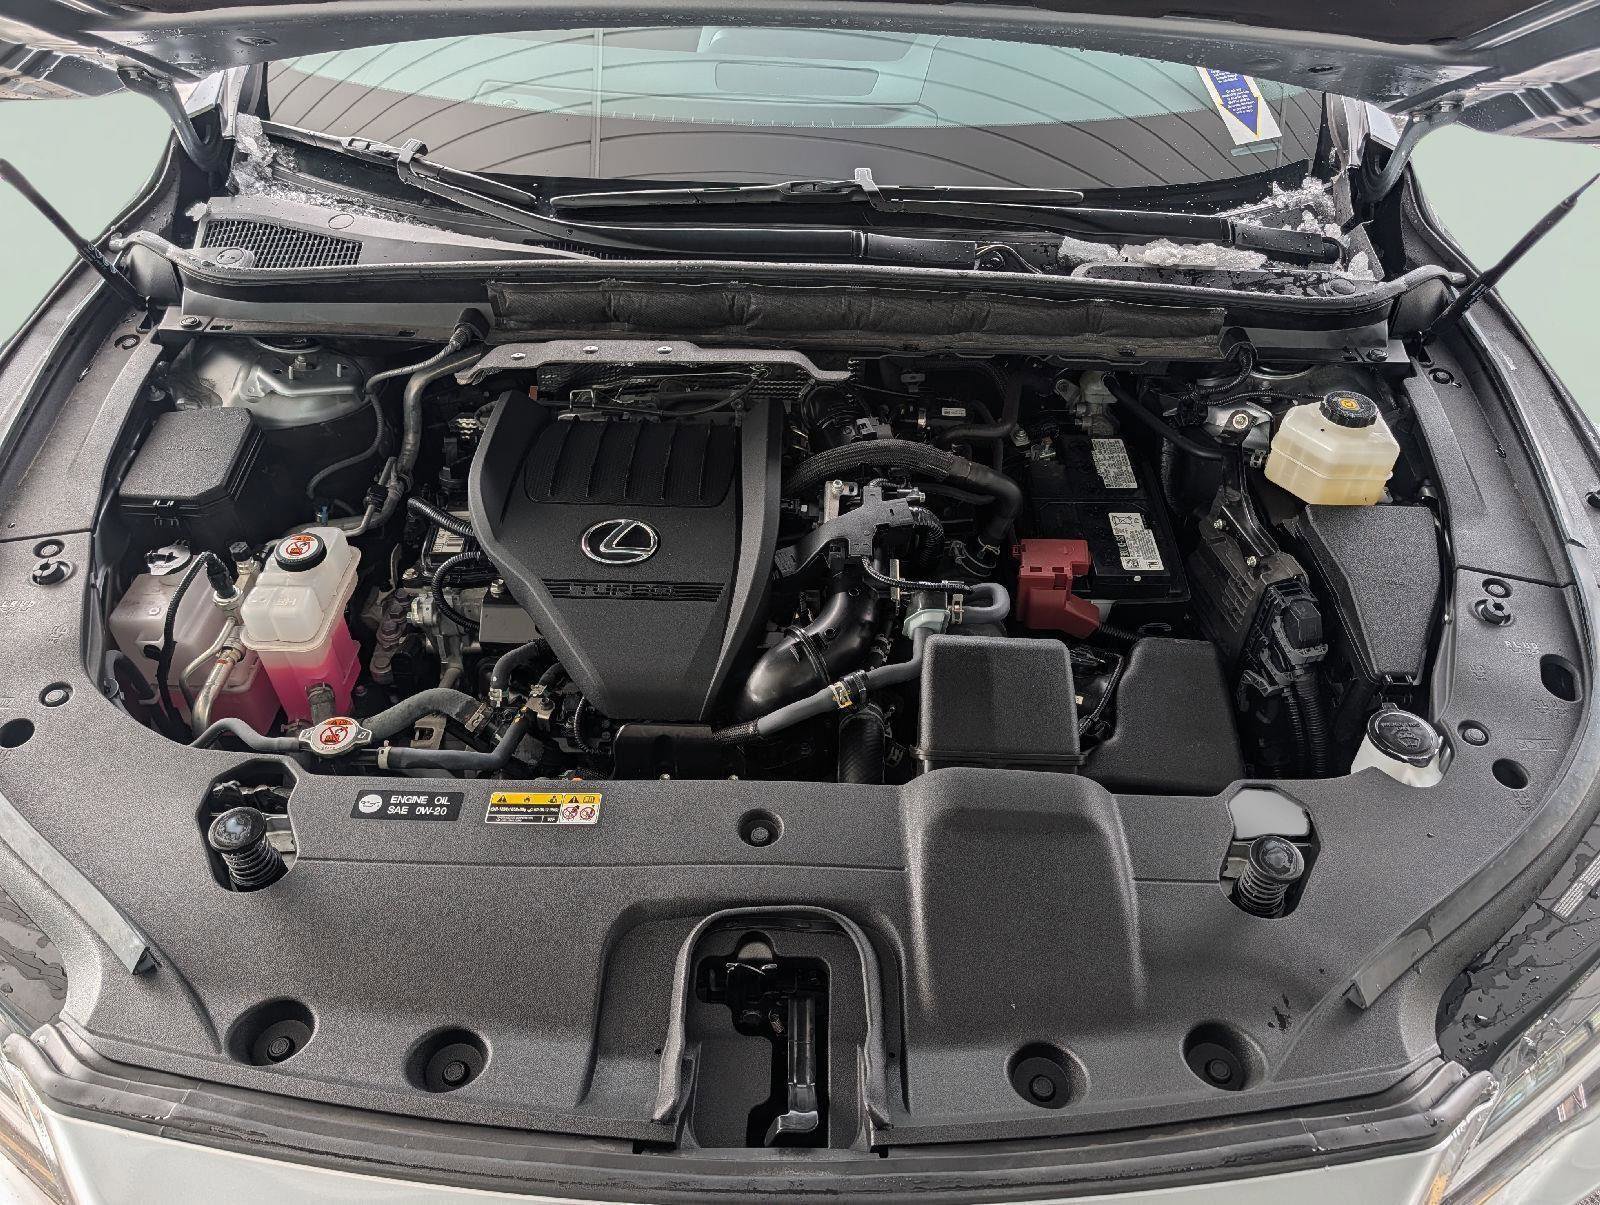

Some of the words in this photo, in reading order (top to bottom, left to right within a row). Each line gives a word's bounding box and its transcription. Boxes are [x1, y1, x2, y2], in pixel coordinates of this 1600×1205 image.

[390, 795, 429, 804] ENGINE
[434, 796, 451, 805] OIL
[387, 806, 409, 815] SAE
[415, 806, 447, 815] 0W-20
